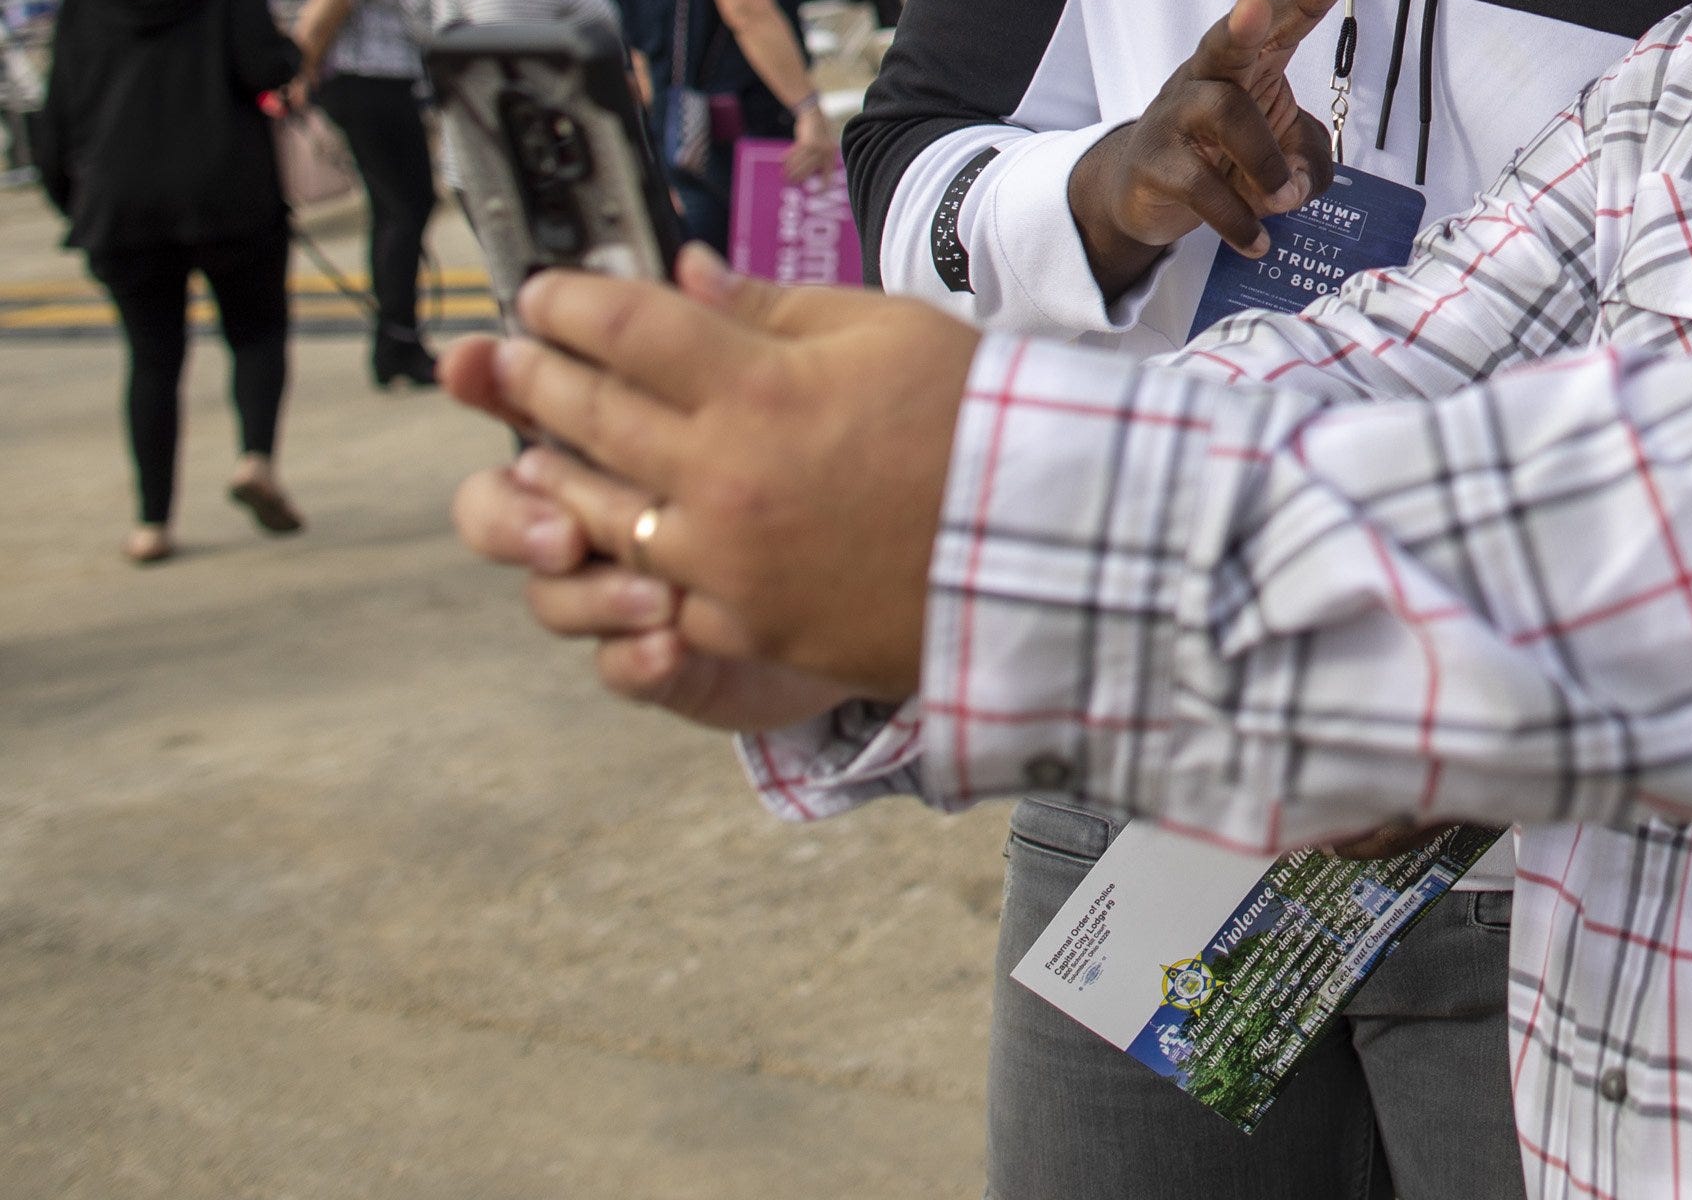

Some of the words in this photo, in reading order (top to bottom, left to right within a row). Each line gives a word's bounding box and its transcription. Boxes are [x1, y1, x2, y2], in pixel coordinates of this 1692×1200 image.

[1292, 233, 1342, 259] TEXT
[1301, 206, 1352, 228] PENCE
[1309, 198, 1361, 220] RUMP
[1257, 261, 1282, 280] TO
[1277, 248, 1345, 279] TRUMP
[1044, 935, 1074, 970] Fraternal
[1069, 914, 1091, 937] Order
[1088, 904, 1097, 915] of
[1093, 882, 1116, 906] Police
[1053, 948, 1076, 975] Capital
[1073, 933, 1090, 949] City
[1086, 909, 1107, 933] Lodge
[1104, 898, 1116, 910] #9
[1093, 922, 1107, 938] Court
[1214, 886, 1275, 957] Violence
[1270, 867, 1290, 888] in
[1286, 842, 1312, 870] the
[1270, 987, 1290, 1009] Can
[1300, 942, 1323, 973] count
[1320, 930, 1333, 946] on
[1332, 913, 1347, 935] you
[1354, 880, 1376, 907] Back
[1373, 869, 1390, 886] the
[1087, 944, 1099, 958] Ohio
[1188, 1015, 1209, 1039] This
[1207, 992, 1226, 1018] year
[1222, 945, 1263, 994] Columbus
[1260, 927, 1277, 947] has
[1276, 906, 1294, 929] seen
[1294, 892, 1305, 907] an
[1305, 854, 1340, 895] alarming
[1195, 1008, 1235, 1057] Felonious
[1230, 968, 1269, 1009] Assaults.
[1266, 949, 1279, 963] To
[1276, 929, 1296, 951] date
[1293, 908, 1312, 932] four
[1310, 892, 1326, 910] law
[1208, 1044, 1226, 1068] shot
[1223, 1035, 1234, 1048] in
[1231, 1018, 1247, 1036] the
[1245, 999, 1261, 1017] city
[1260, 977, 1276, 1000] and
[1274, 942, 1306, 981] another
[1335, 874, 1364, 906] Dozens
[1251, 1036, 1270, 1060] Tell
[1267, 1025, 1279, 1040] us
[1278, 1005, 1296, 1026] why
[1293, 986, 1309, 1008] you
[1308, 949, 1337, 987] support
[1352, 906, 1373, 931] local
[1373, 884, 1395, 911] police
[1396, 873, 1405, 887] at
[1326, 962, 1354, 995] Check
[1353, 946, 1367, 966] out
[1364, 889, 1417, 951] Cbustruth.net
